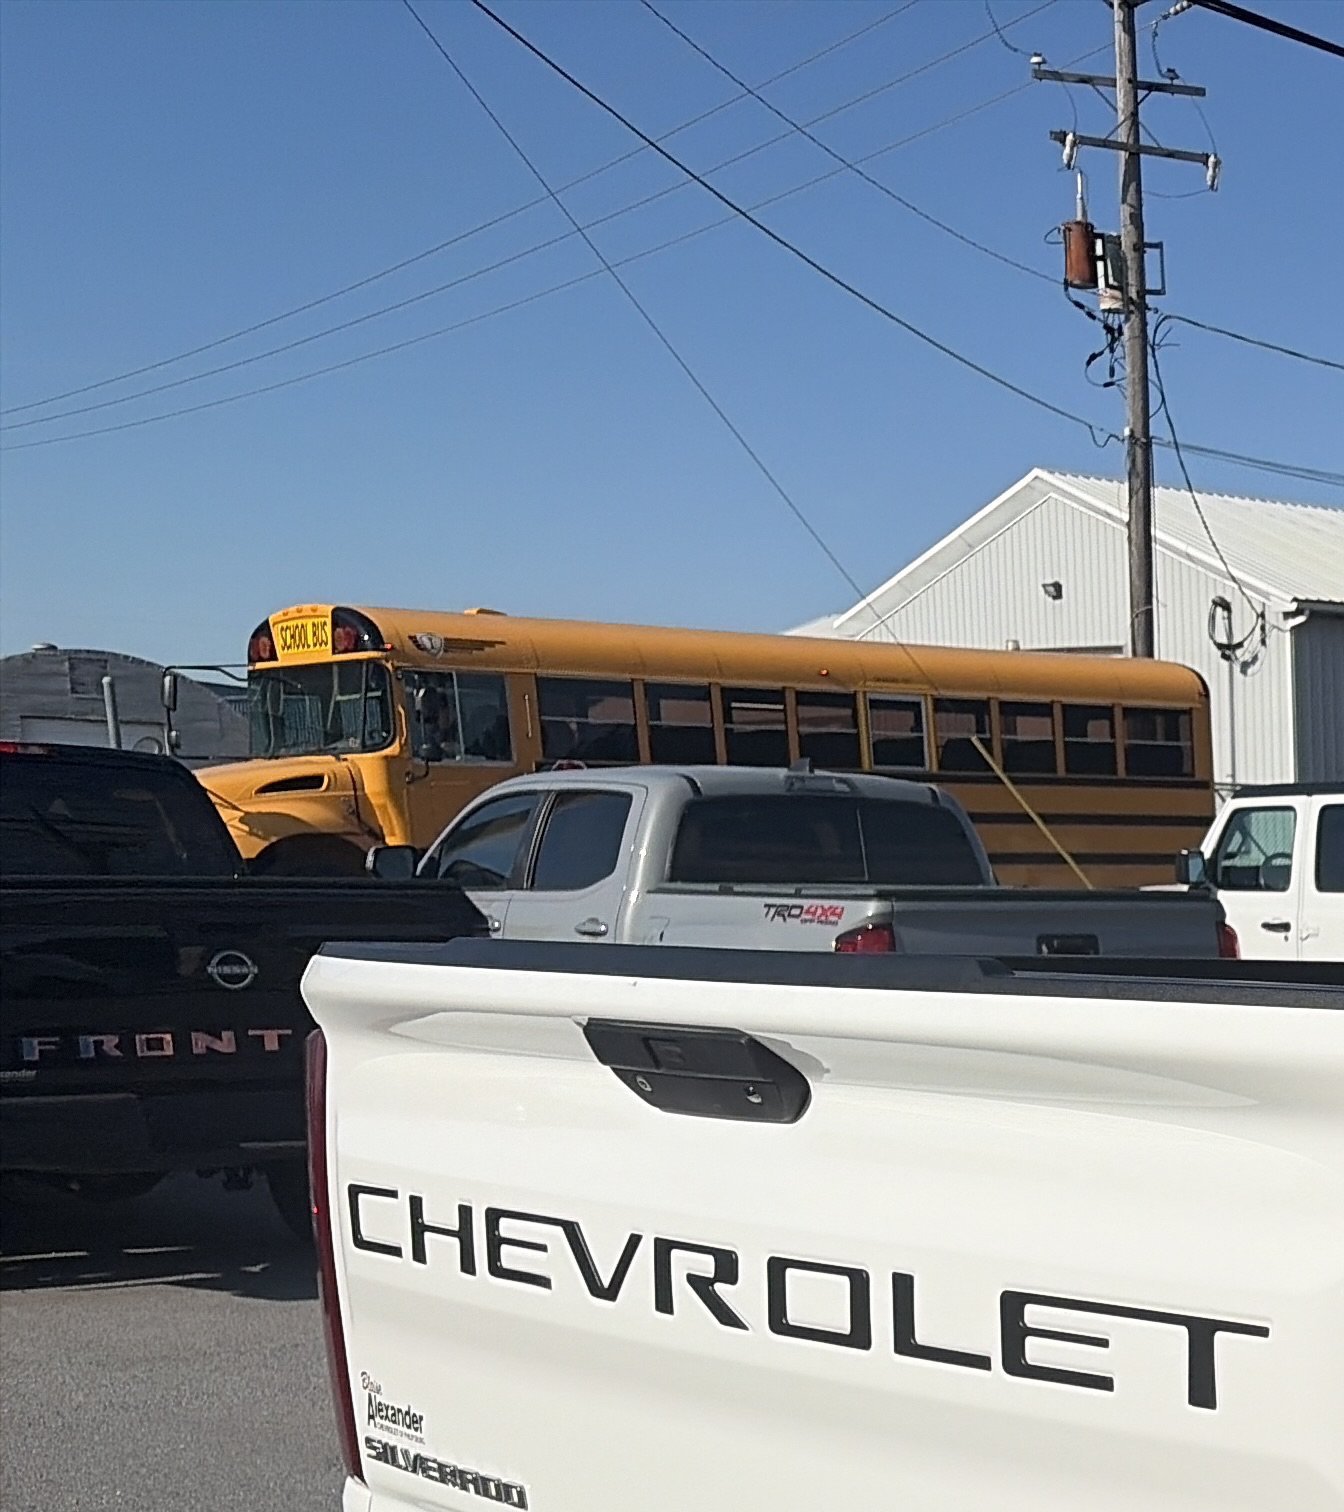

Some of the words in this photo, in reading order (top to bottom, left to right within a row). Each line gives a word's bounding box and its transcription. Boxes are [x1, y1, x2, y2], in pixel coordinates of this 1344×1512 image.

[280, 623, 310, 651] SCHOOL
[312, 621, 329, 647] BUS
[763, 903, 804, 922] TRD
[206, 964, 259, 975] NISSAN
[347, 1182, 1271, 1411] CHEVROLET
[367, 1392, 424, 1434] Alexander
[364, 1435, 529, 1511] SILVERADO
